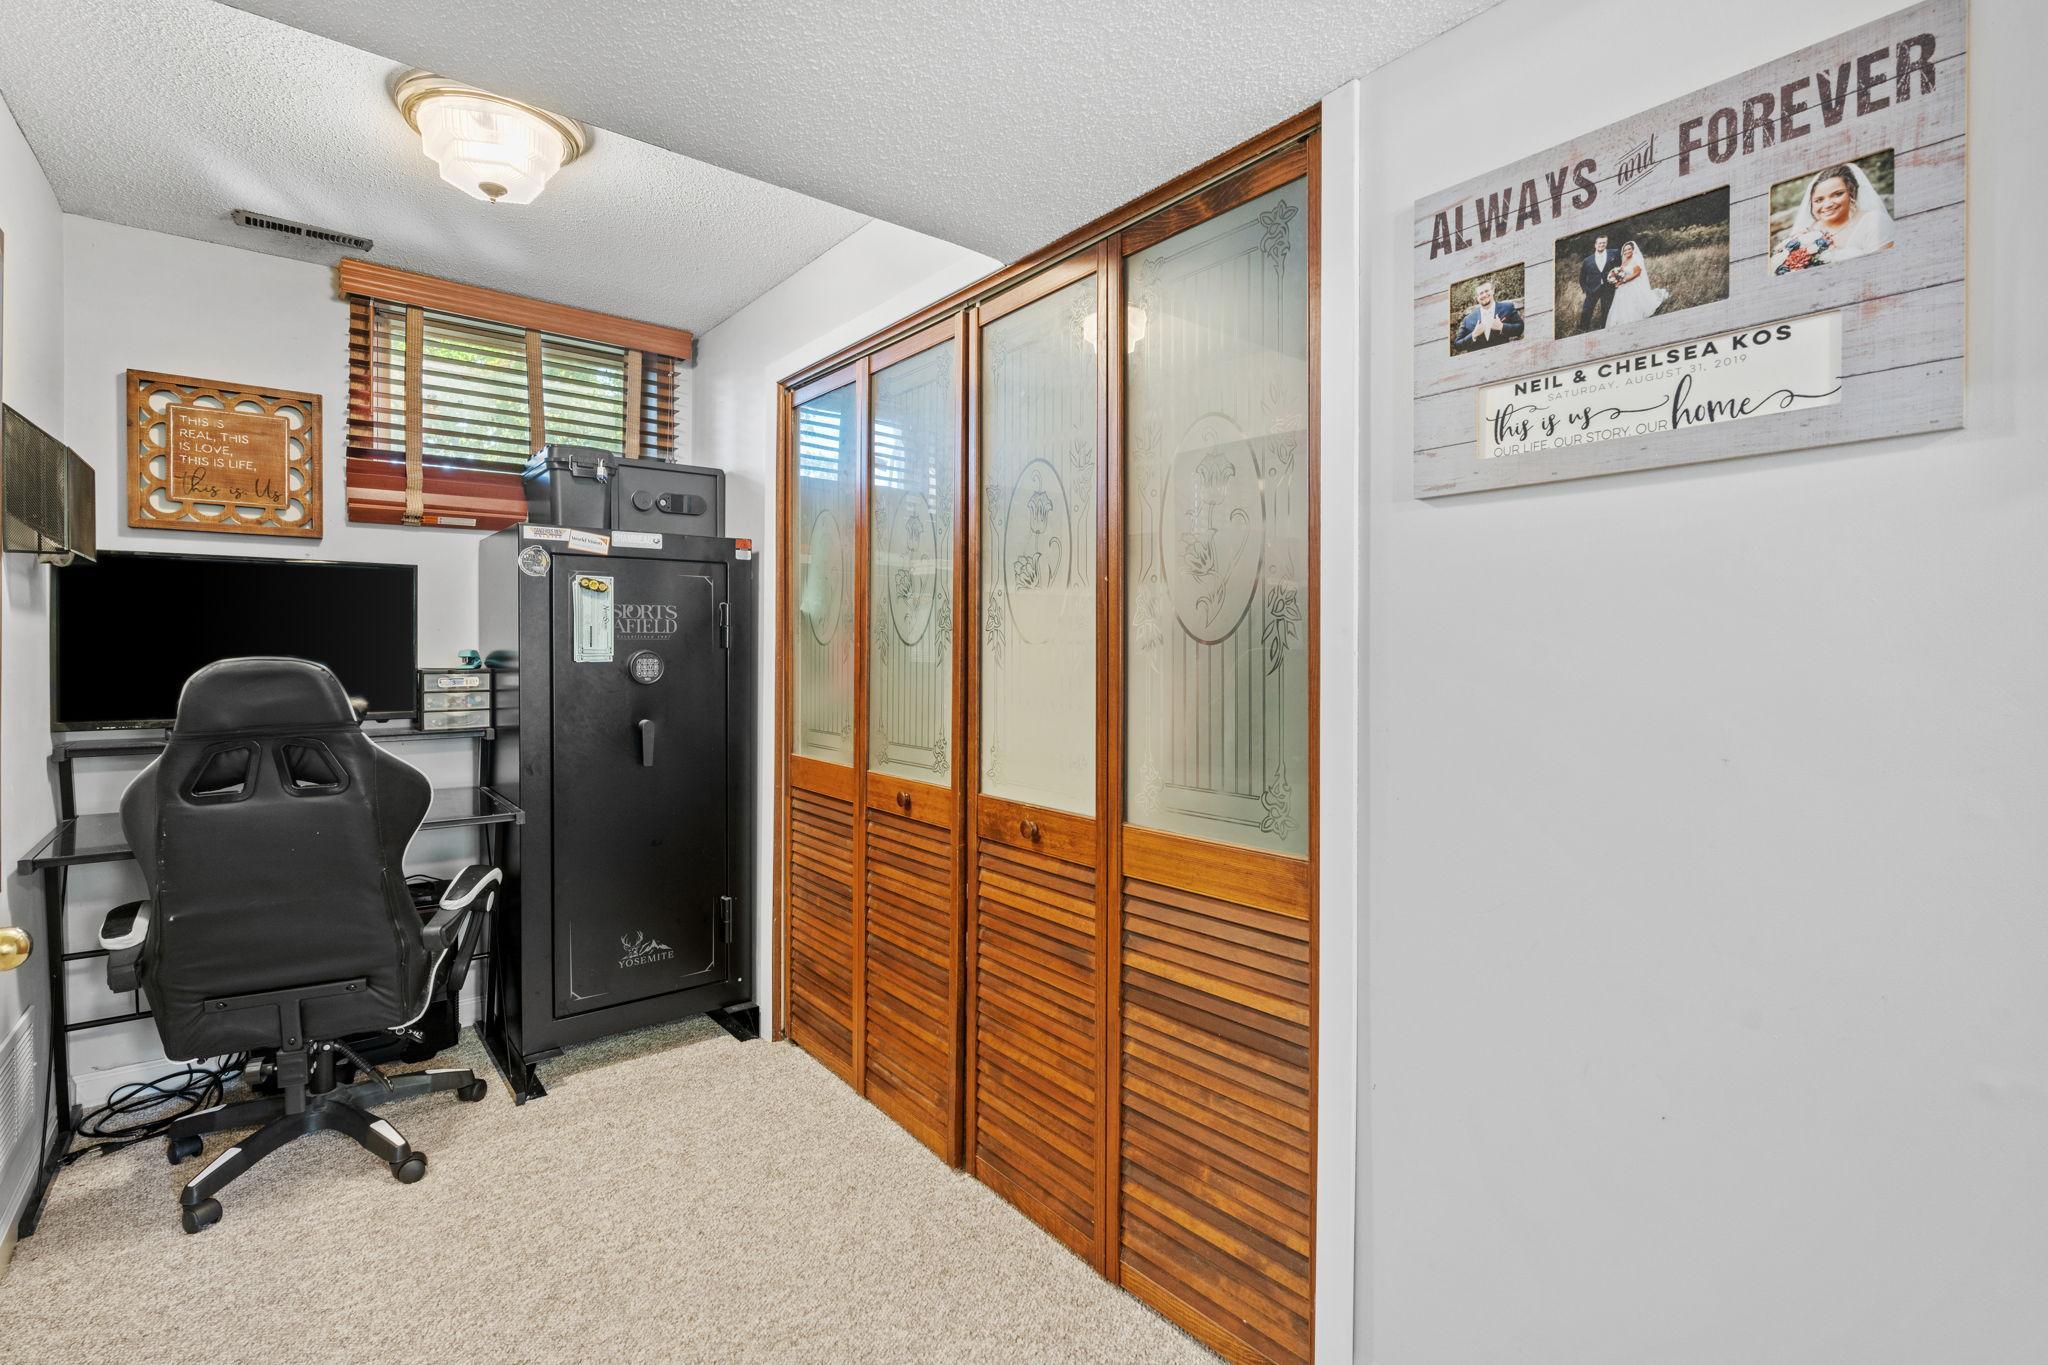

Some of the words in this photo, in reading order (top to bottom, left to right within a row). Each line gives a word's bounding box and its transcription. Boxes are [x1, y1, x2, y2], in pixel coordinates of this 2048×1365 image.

[1429, 157, 1598, 260] ALWAYS
[1616, 133, 1657, 187] and
[1678, 32, 1937, 178] FOREVER
[1514, 375, 1563, 396] NEIL
[1573, 370, 1586, 383] &
[1598, 341, 1719, 378] CHELSEA
[1732, 325, 1792, 350] KOS
[1625, 367, 1682, 386] AUGUST
[1714, 354, 1748, 369] 2019
[179, 415, 209, 427] THIS
[213, 419, 225, 429] IS
[1486, 403, 1549, 445] this
[1541, 413, 1560, 437] is
[179, 428, 216, 443] REAL,
[220, 432, 249, 444] THIS
[1493, 444, 1520, 458] OUR
[1554, 434, 1582, 448] OUR
[1636, 419, 1668, 435] OUR
[179, 441, 191, 451] IS
[195, 443, 233, 457] LOVE,
[179, 454, 209, 466] THIS
[213, 458, 224, 468] IS
[228, 459, 257, 472] LIFE,
[614, 604, 678, 620] SPORTS
[614, 618, 678, 634] AFIELD
[618, 951, 674, 968] YOSEMITE
